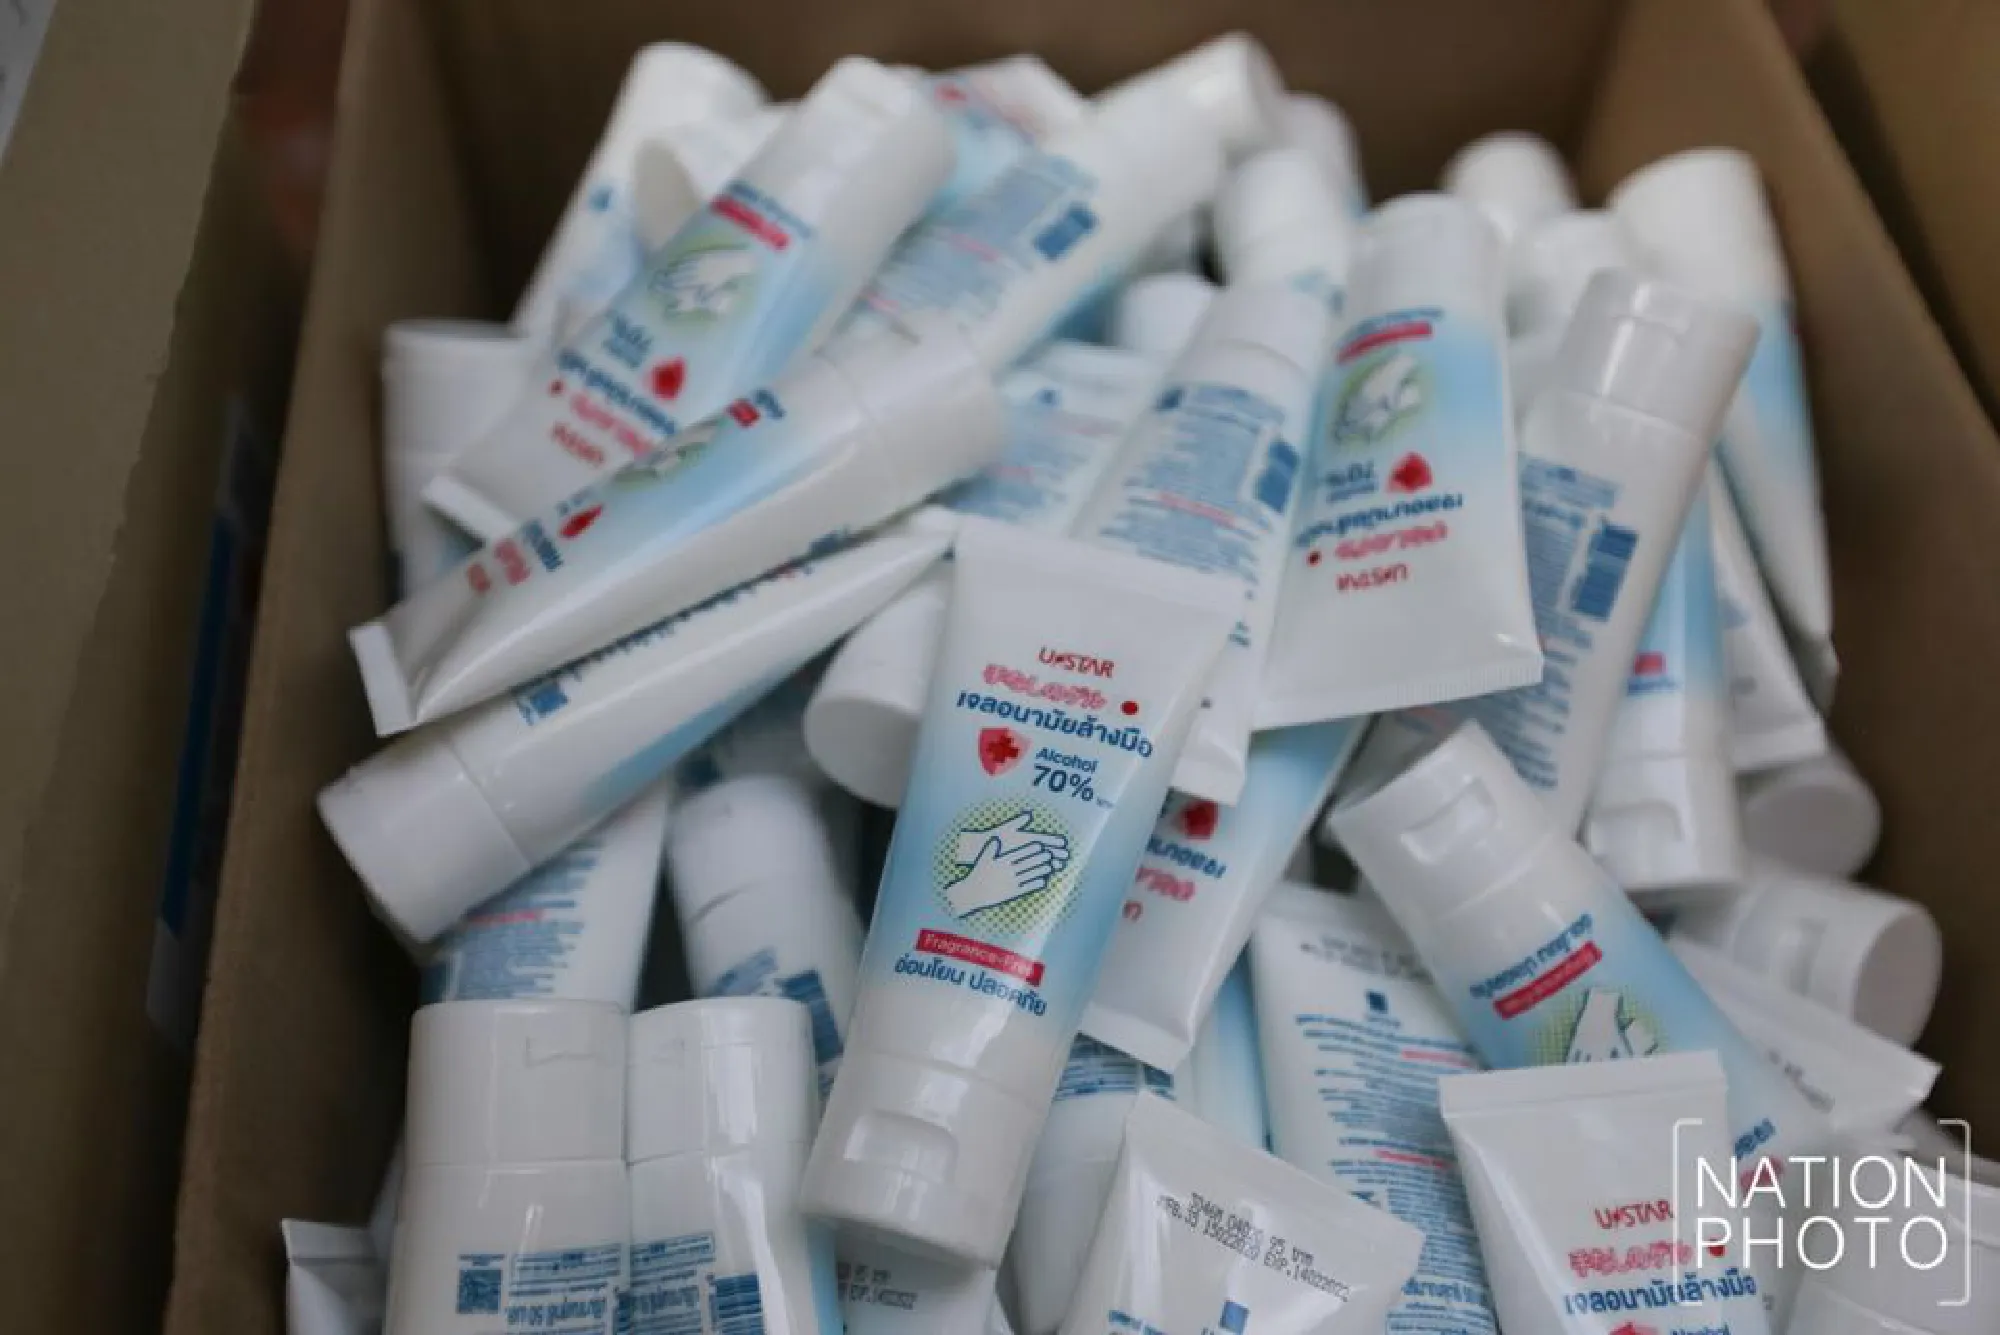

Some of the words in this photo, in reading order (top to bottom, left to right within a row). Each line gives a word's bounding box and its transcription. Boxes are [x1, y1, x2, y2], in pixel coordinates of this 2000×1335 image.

[956, 690, 1154, 758] เจลอนามัยล้างมือ
[1035, 746, 1098, 773] Alcohol
[1032, 764, 1095, 802] 70%
[894, 952, 966, 986] อ่อนโยน
